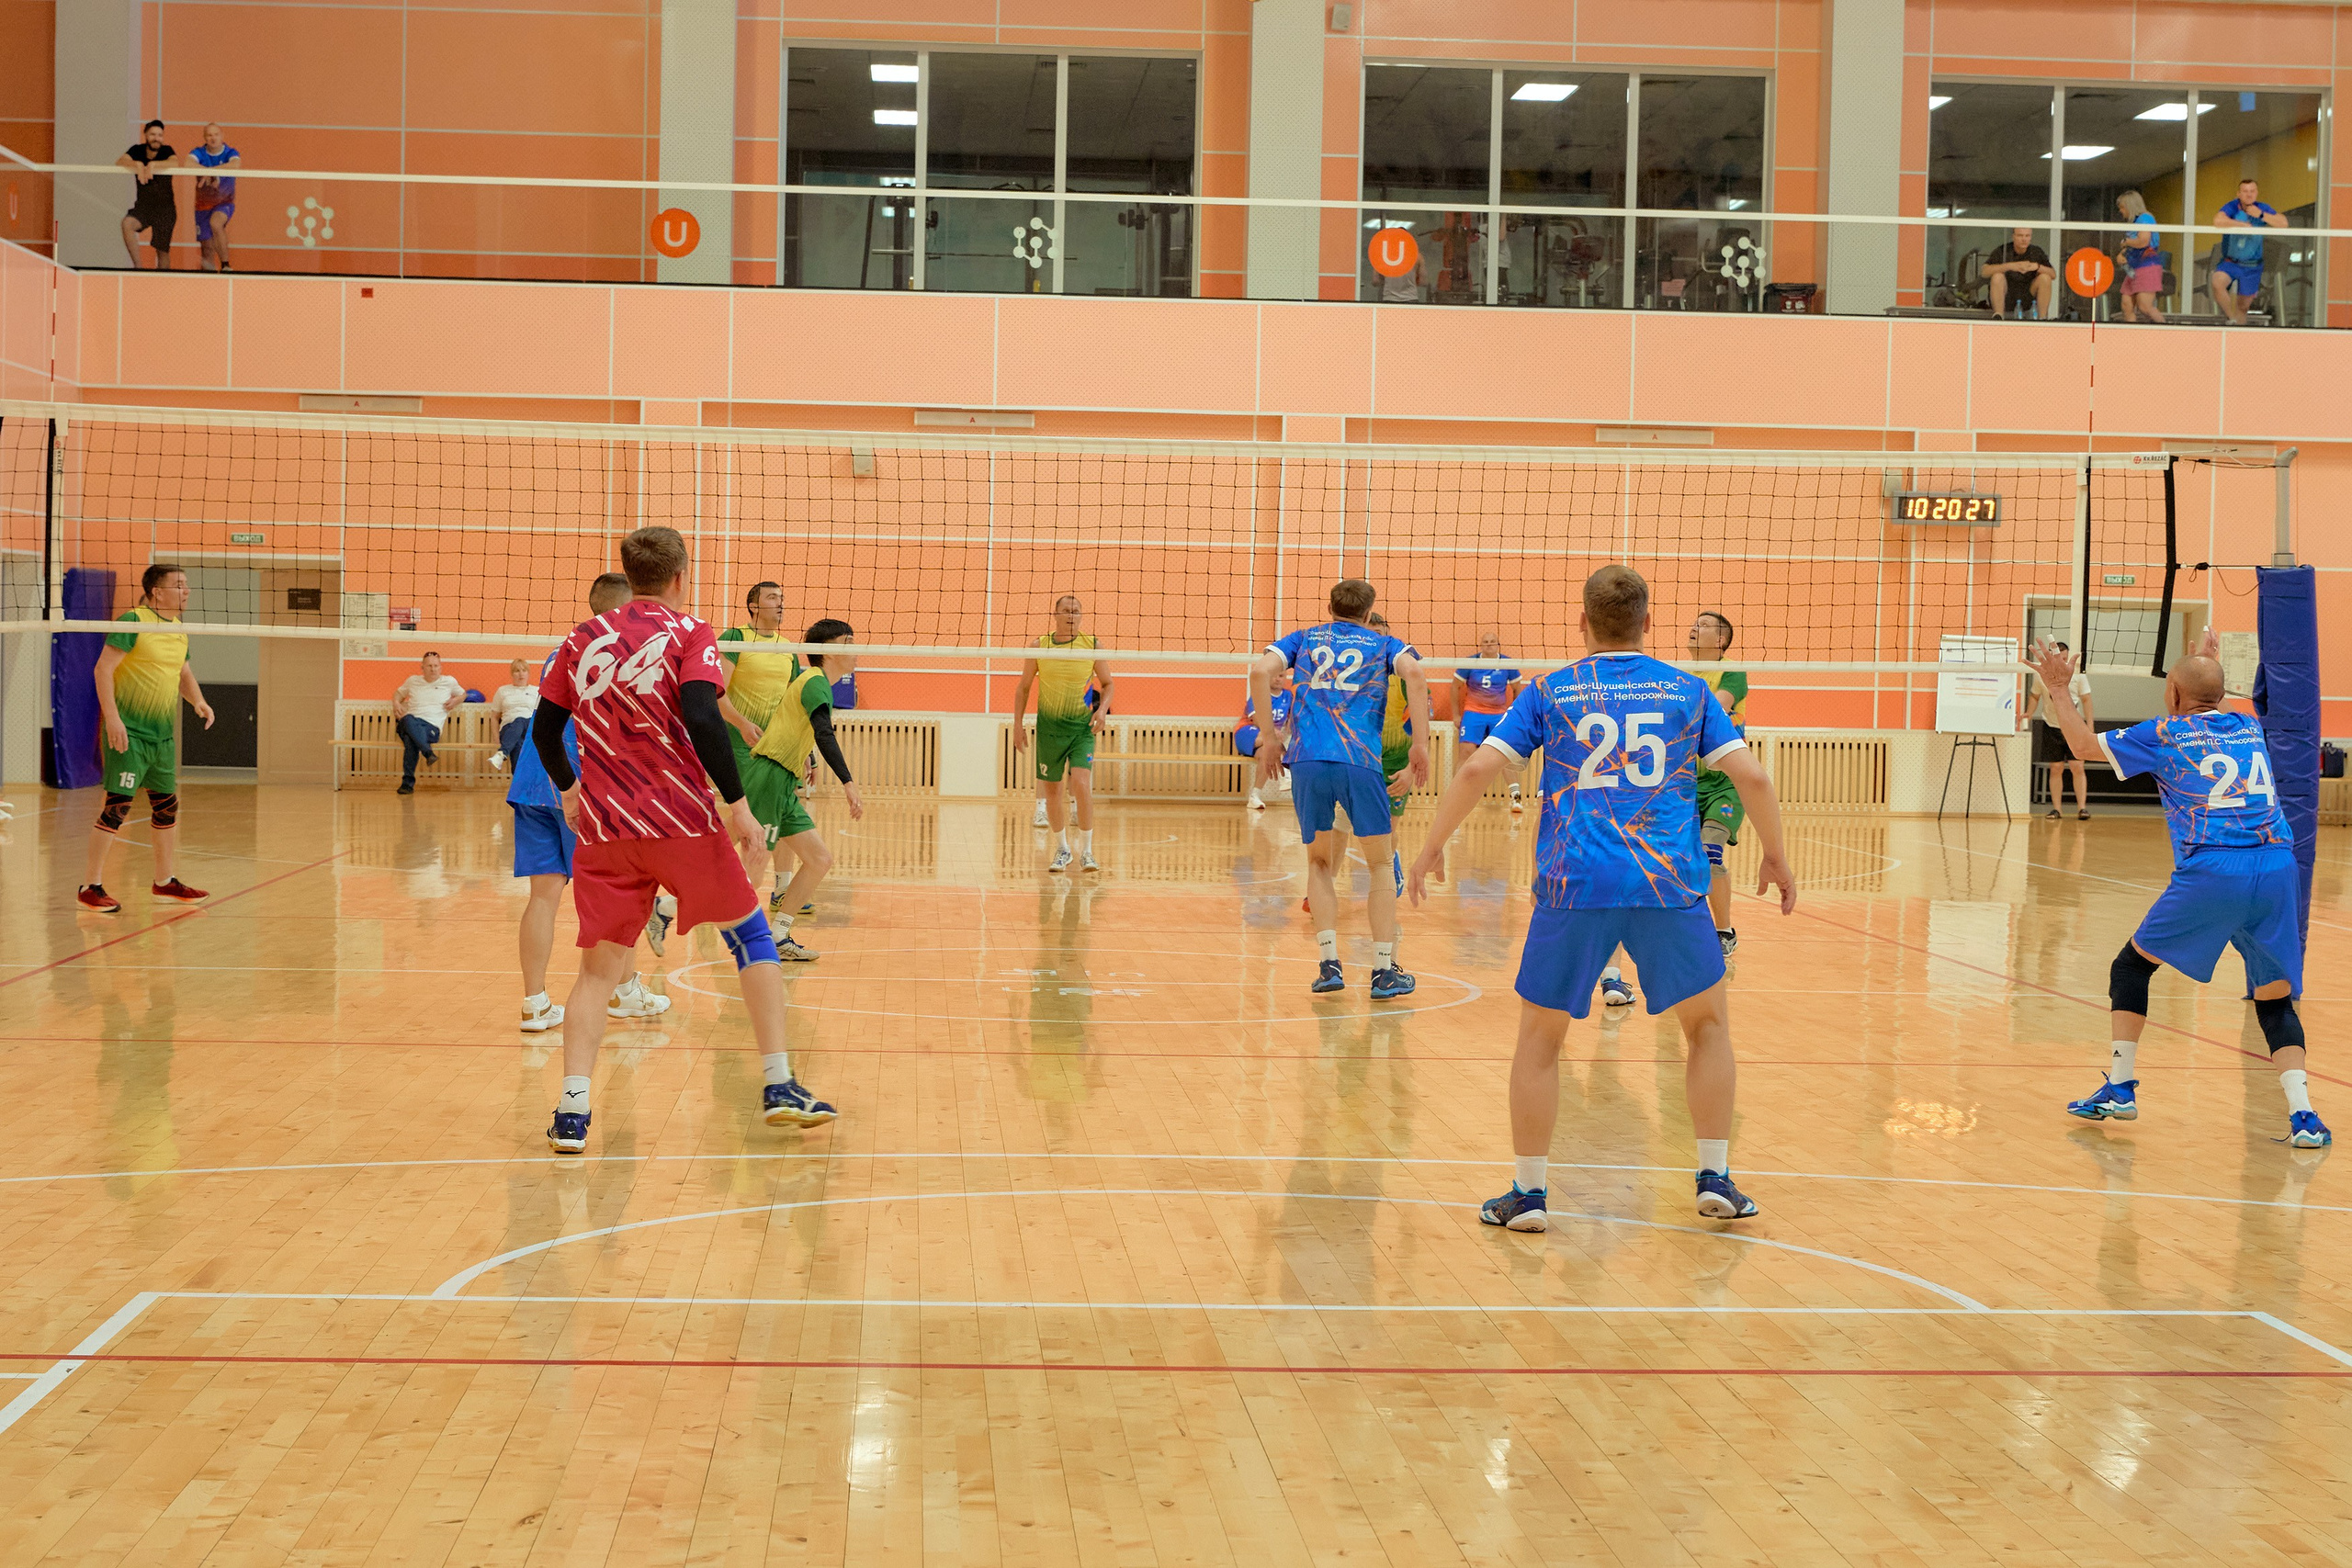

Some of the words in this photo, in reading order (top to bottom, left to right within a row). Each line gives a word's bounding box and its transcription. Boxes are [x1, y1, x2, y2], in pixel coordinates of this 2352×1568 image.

[664, 220, 687, 247] U
[1382, 240, 1405, 266] U
[2078, 260, 2101, 286] U
[1907, 497, 1928, 520] 10
[1932, 498, 1962, 520] 20
[1965, 499, 1996, 521] 27
[575, 631, 673, 708] 64
[1311, 645, 1363, 692] 22
[1481, 675, 1492, 689] 5
[1554, 681, 1657, 694] Саяно-Шушенская
[1658, 681, 1679, 691] ГЭС
[1555, 694, 1589, 705] имени
[1591, 692, 1612, 701] П.С.
[1614, 692, 1686, 703] Непорожнего
[1460, 727, 1466, 737] 5
[2177, 739, 2206, 750] имени
[2207, 738, 2223, 746] П.С.
[1575, 712, 1667, 790] 25
[119, 772, 136, 789] 15
[2199, 751, 2276, 809] 24
[763, 823, 779, 843] 11
